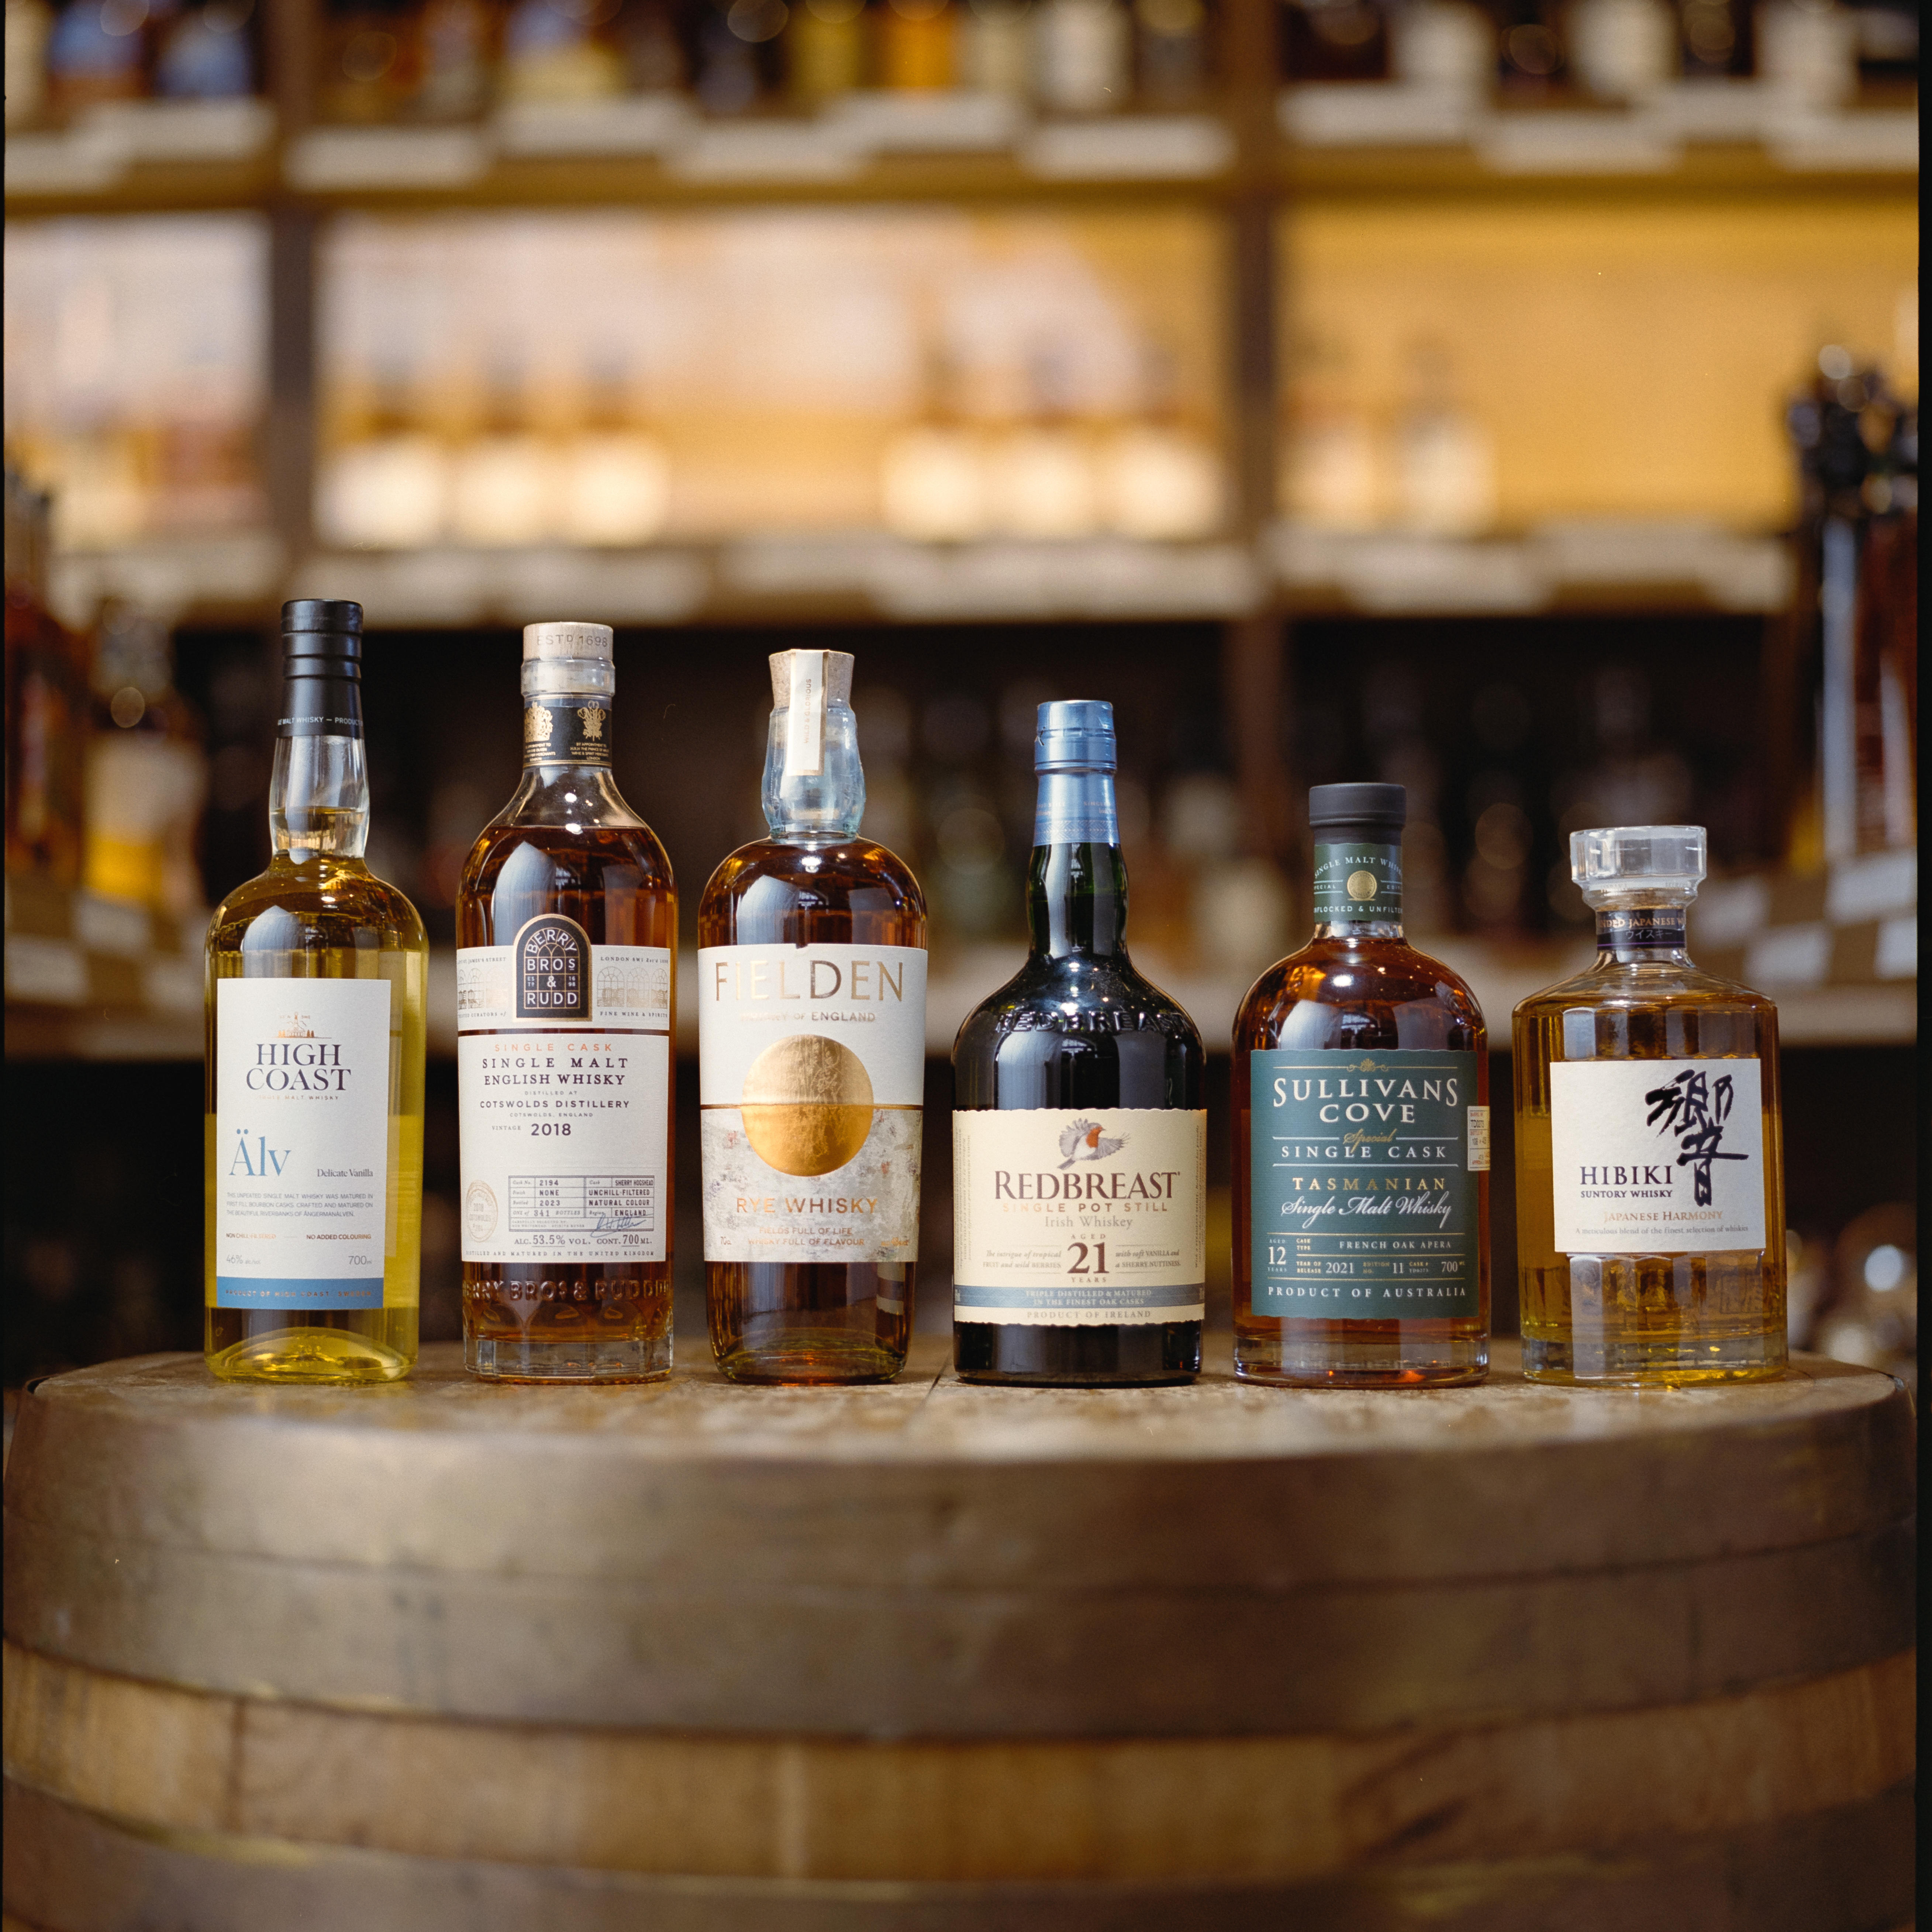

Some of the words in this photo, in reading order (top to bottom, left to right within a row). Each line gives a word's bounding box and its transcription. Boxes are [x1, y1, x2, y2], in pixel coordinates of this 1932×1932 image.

[537, 635, 573, 645] ESTD
[579, 636, 608, 647] 1698
[1625, 930, 1673, 939] ウイスキー
[527, 929, 577, 953] BERRY
[527, 959, 576, 971] BROS
[546, 975, 557, 989] &
[716, 959, 903, 1001] FIELDEN
[527, 993, 577, 1005] RUDD
[811, 1011, 876, 1022] ENGLAND
[494, 1043, 555, 1052] SINGLE
[256, 1044, 342, 1066] HIGH
[482, 1058, 555, 1069] SINGLE
[570, 1058, 628, 1068] MALT
[246, 1068, 351, 1091] COAST
[484, 1074, 551, 1085] ENGLISH
[557, 1074, 625, 1085] WHISKY
[1273, 1077, 1458, 1107] SULLIVANS
[480, 1100, 549, 1108] COTSWOLDS
[1319, 1103, 1415, 1124] COVE
[530, 1123, 572, 1136] 2018
[1342, 1128, 1398, 1153] Special
[1645, 1069, 1749, 1207] 響
[228, 1128, 292, 1176] Älv
[1281, 1146, 1372, 1158] SINGLE
[1388, 1146, 1446, 1158] CASK
[349, 1168, 373, 1177] Vanilla
[1580, 1165, 1673, 1185] HIBIKI
[995, 1171, 1178, 1200] REDBREAST
[1293, 1177, 1445, 1191] TASMANIAN
[1631, 1190, 1673, 1198] WHISKY
[736, 1198, 775, 1213] RYE
[785, 1198, 878, 1214] WHISKY
[1003, 1203, 1066, 1213] SINGLE
[1078, 1203, 1112, 1213] POT
[1124, 1202, 1167, 1212] STILL
[1281, 1195, 1336, 1229] Single
[1338, 1196, 1392, 1215] Malt
[1394, 1191, 1452, 1229] Whisky
[1045, 1216, 1073, 1228] Irish
[1079, 1216, 1133, 1229] Whiskey
[1604, 1211, 1659, 1223] JAPANESE
[1663, 1211, 1723, 1221] HARMONY
[532, 1235, 566, 1245] 53.5%
[622, 1234, 639, 1245] 700
[1339, 1241, 1387, 1249] FRENCH
[1066, 1242, 1110, 1274] 21
[1268, 1246, 1287, 1265] 12
[1326, 1262, 1354, 1274] 2021
[1393, 1262, 1404, 1274] 11
[1441, 1261, 1458, 1272] 700
[1267, 1286, 1340, 1297] PRODUCT
[1352, 1288, 1373, 1298] OF
[1383, 1287, 1466, 1298] AUSTRALIA
